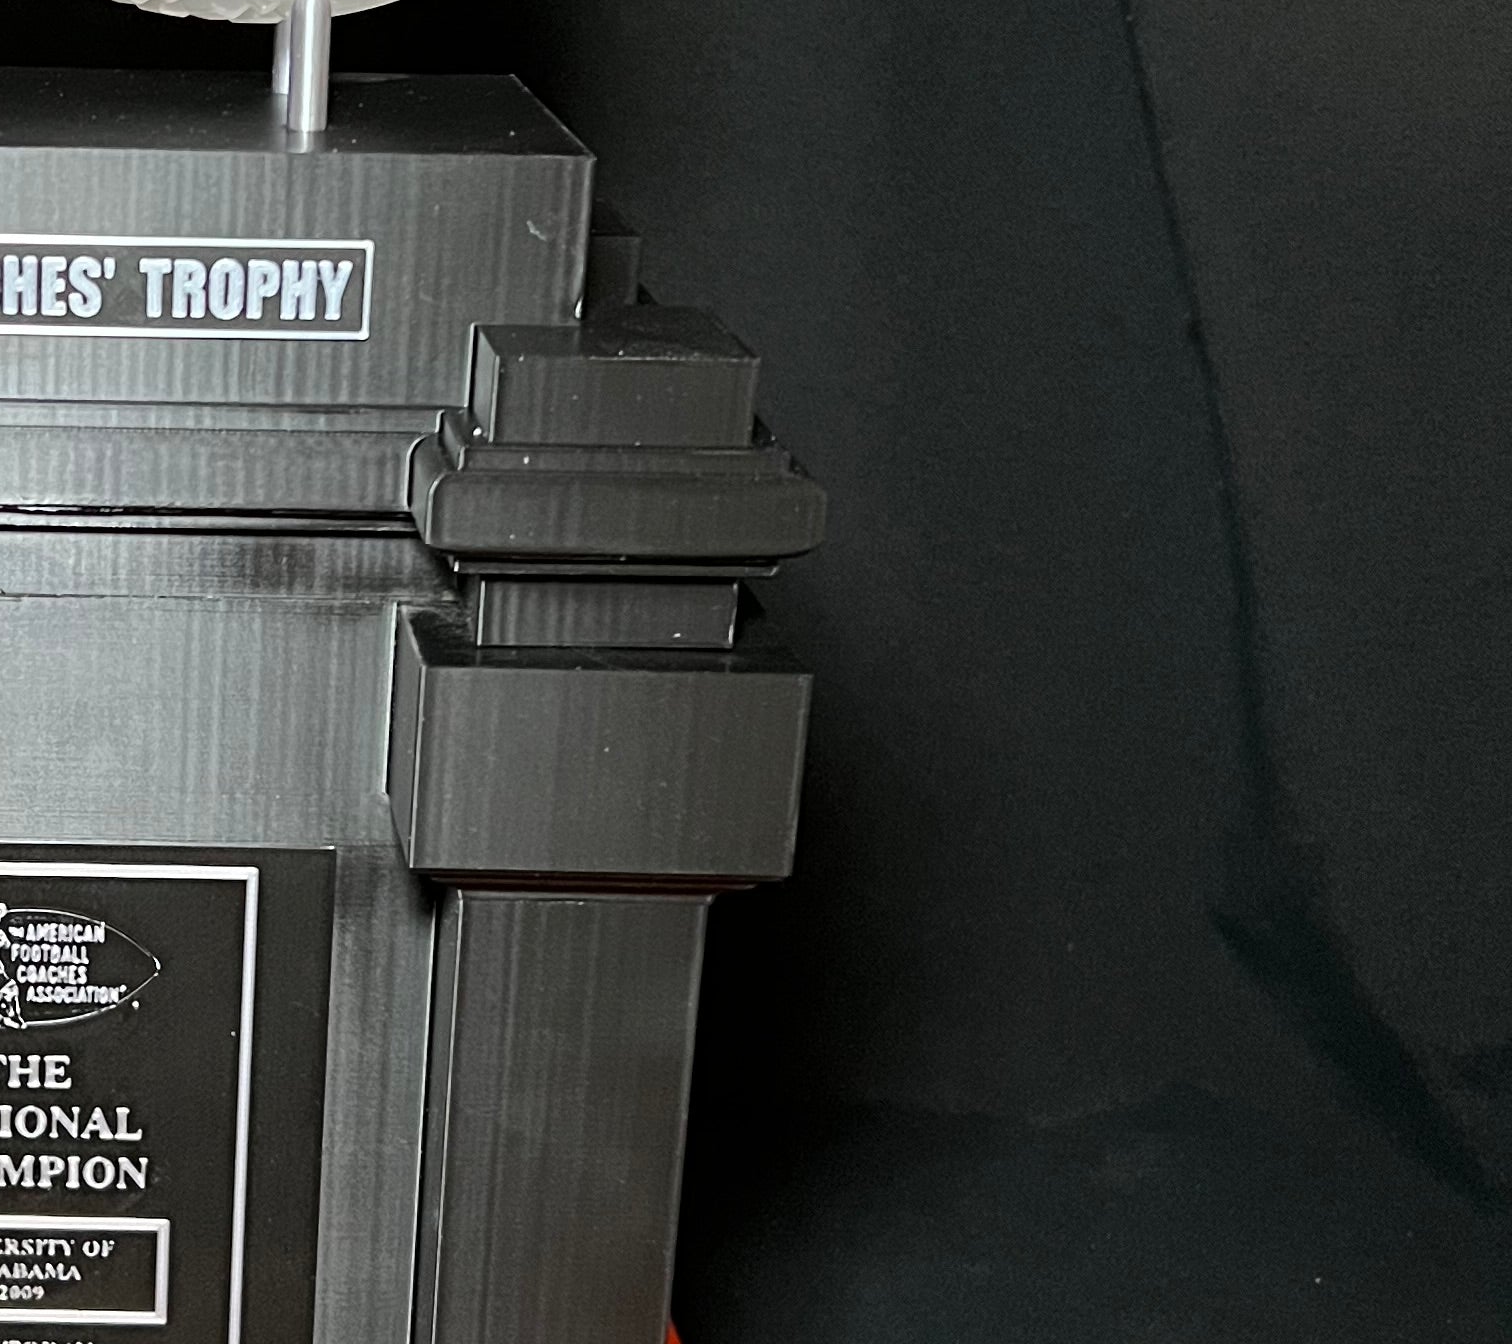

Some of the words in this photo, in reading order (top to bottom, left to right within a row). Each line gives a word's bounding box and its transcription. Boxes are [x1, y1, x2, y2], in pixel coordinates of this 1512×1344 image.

[138, 257, 354, 321] TROPHY
[26, 923, 105, 943] AMERICAN
[11, 943, 89, 964] FOOTBALL
[16, 964, 87, 984] COACHES
[82, 1239, 115, 1258] OF
